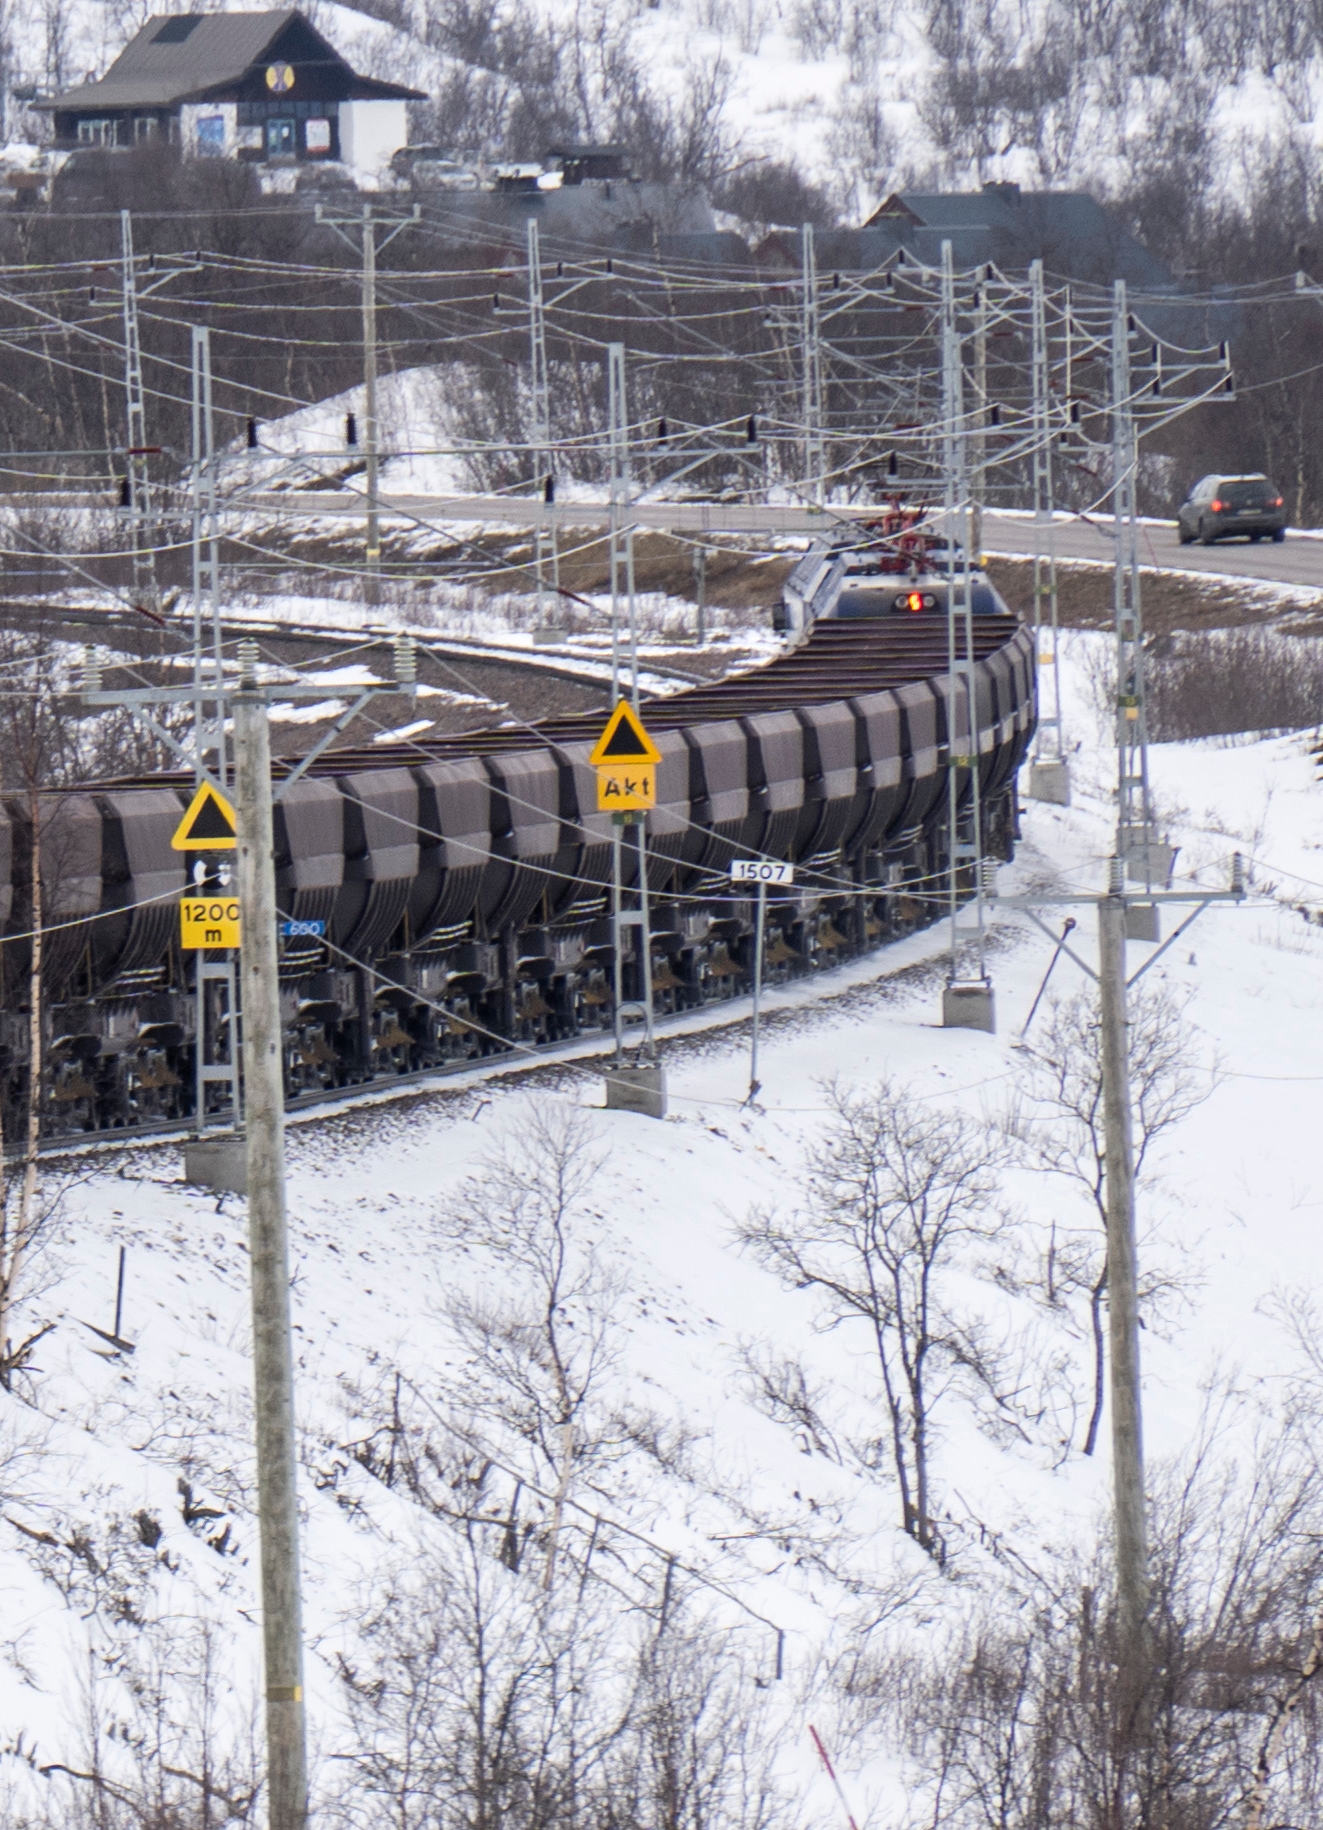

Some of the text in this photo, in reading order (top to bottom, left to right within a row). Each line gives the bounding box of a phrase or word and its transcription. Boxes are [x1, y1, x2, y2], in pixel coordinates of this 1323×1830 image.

[604, 777, 649, 797] Akt
[739, 864, 786, 881] 1507
[184, 903, 240, 922] 1200
[205, 929, 222, 942] m
